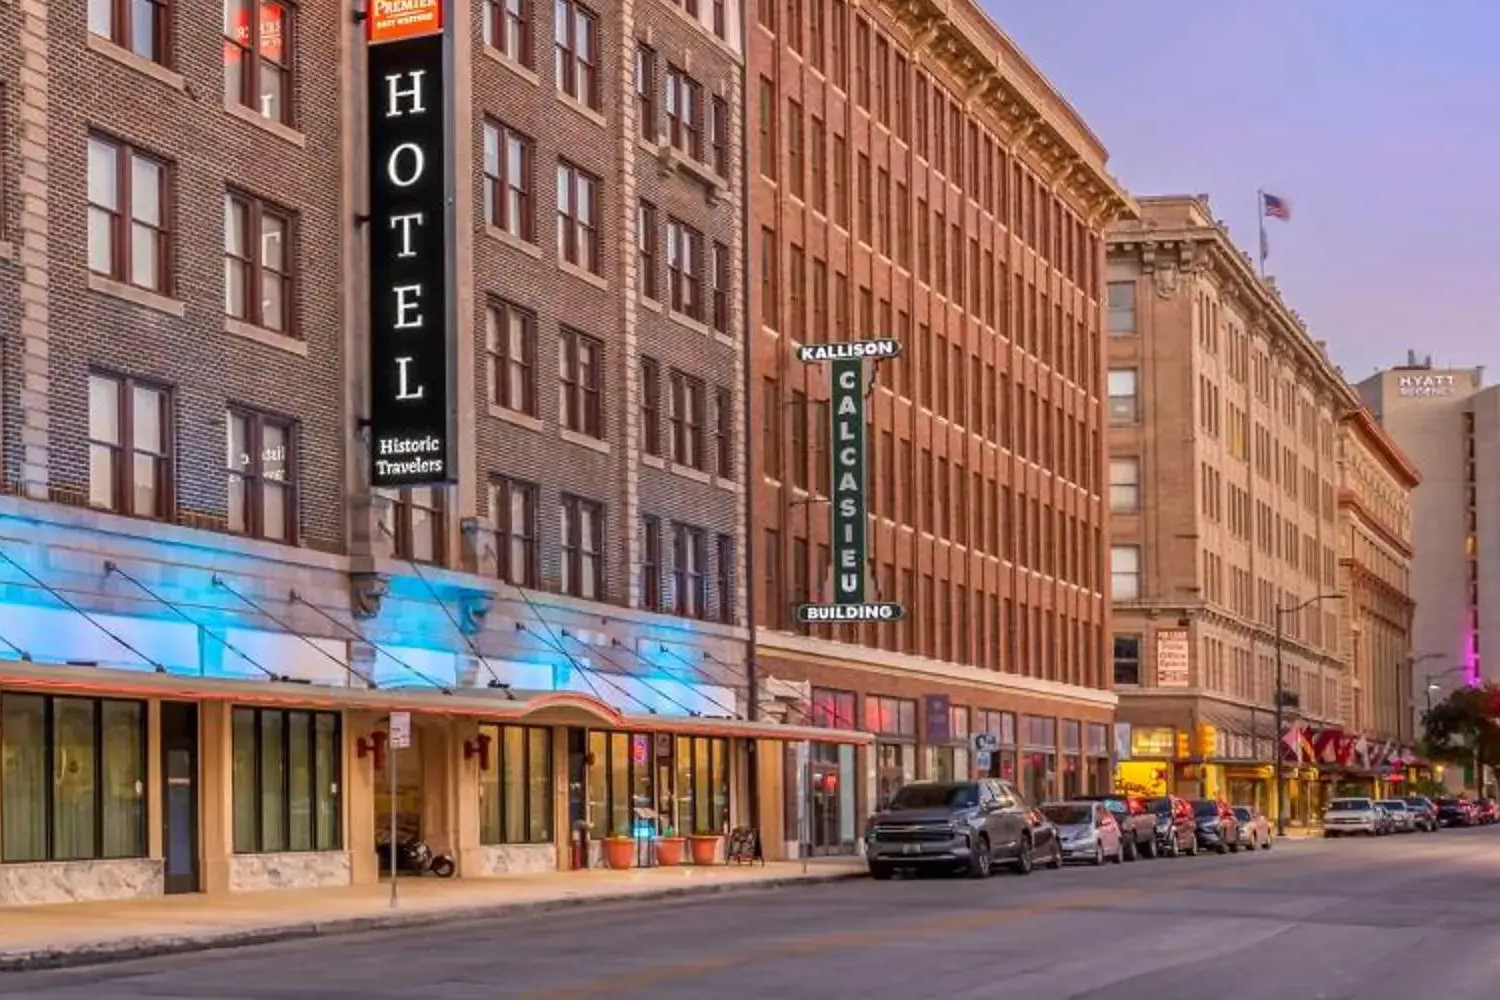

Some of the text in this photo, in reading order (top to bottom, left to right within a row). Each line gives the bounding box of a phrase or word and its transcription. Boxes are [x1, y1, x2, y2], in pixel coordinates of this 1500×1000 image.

[385, 69, 427, 401] HOTEL
[801, 341, 893, 360] KALLISON
[1400, 375, 1454, 386] HYATT
[380, 435, 440, 454] Historic
[377, 456, 443, 477] Travelers
[838, 371, 858, 593] CALCASIEU
[807, 605, 892, 620] BUILDING
